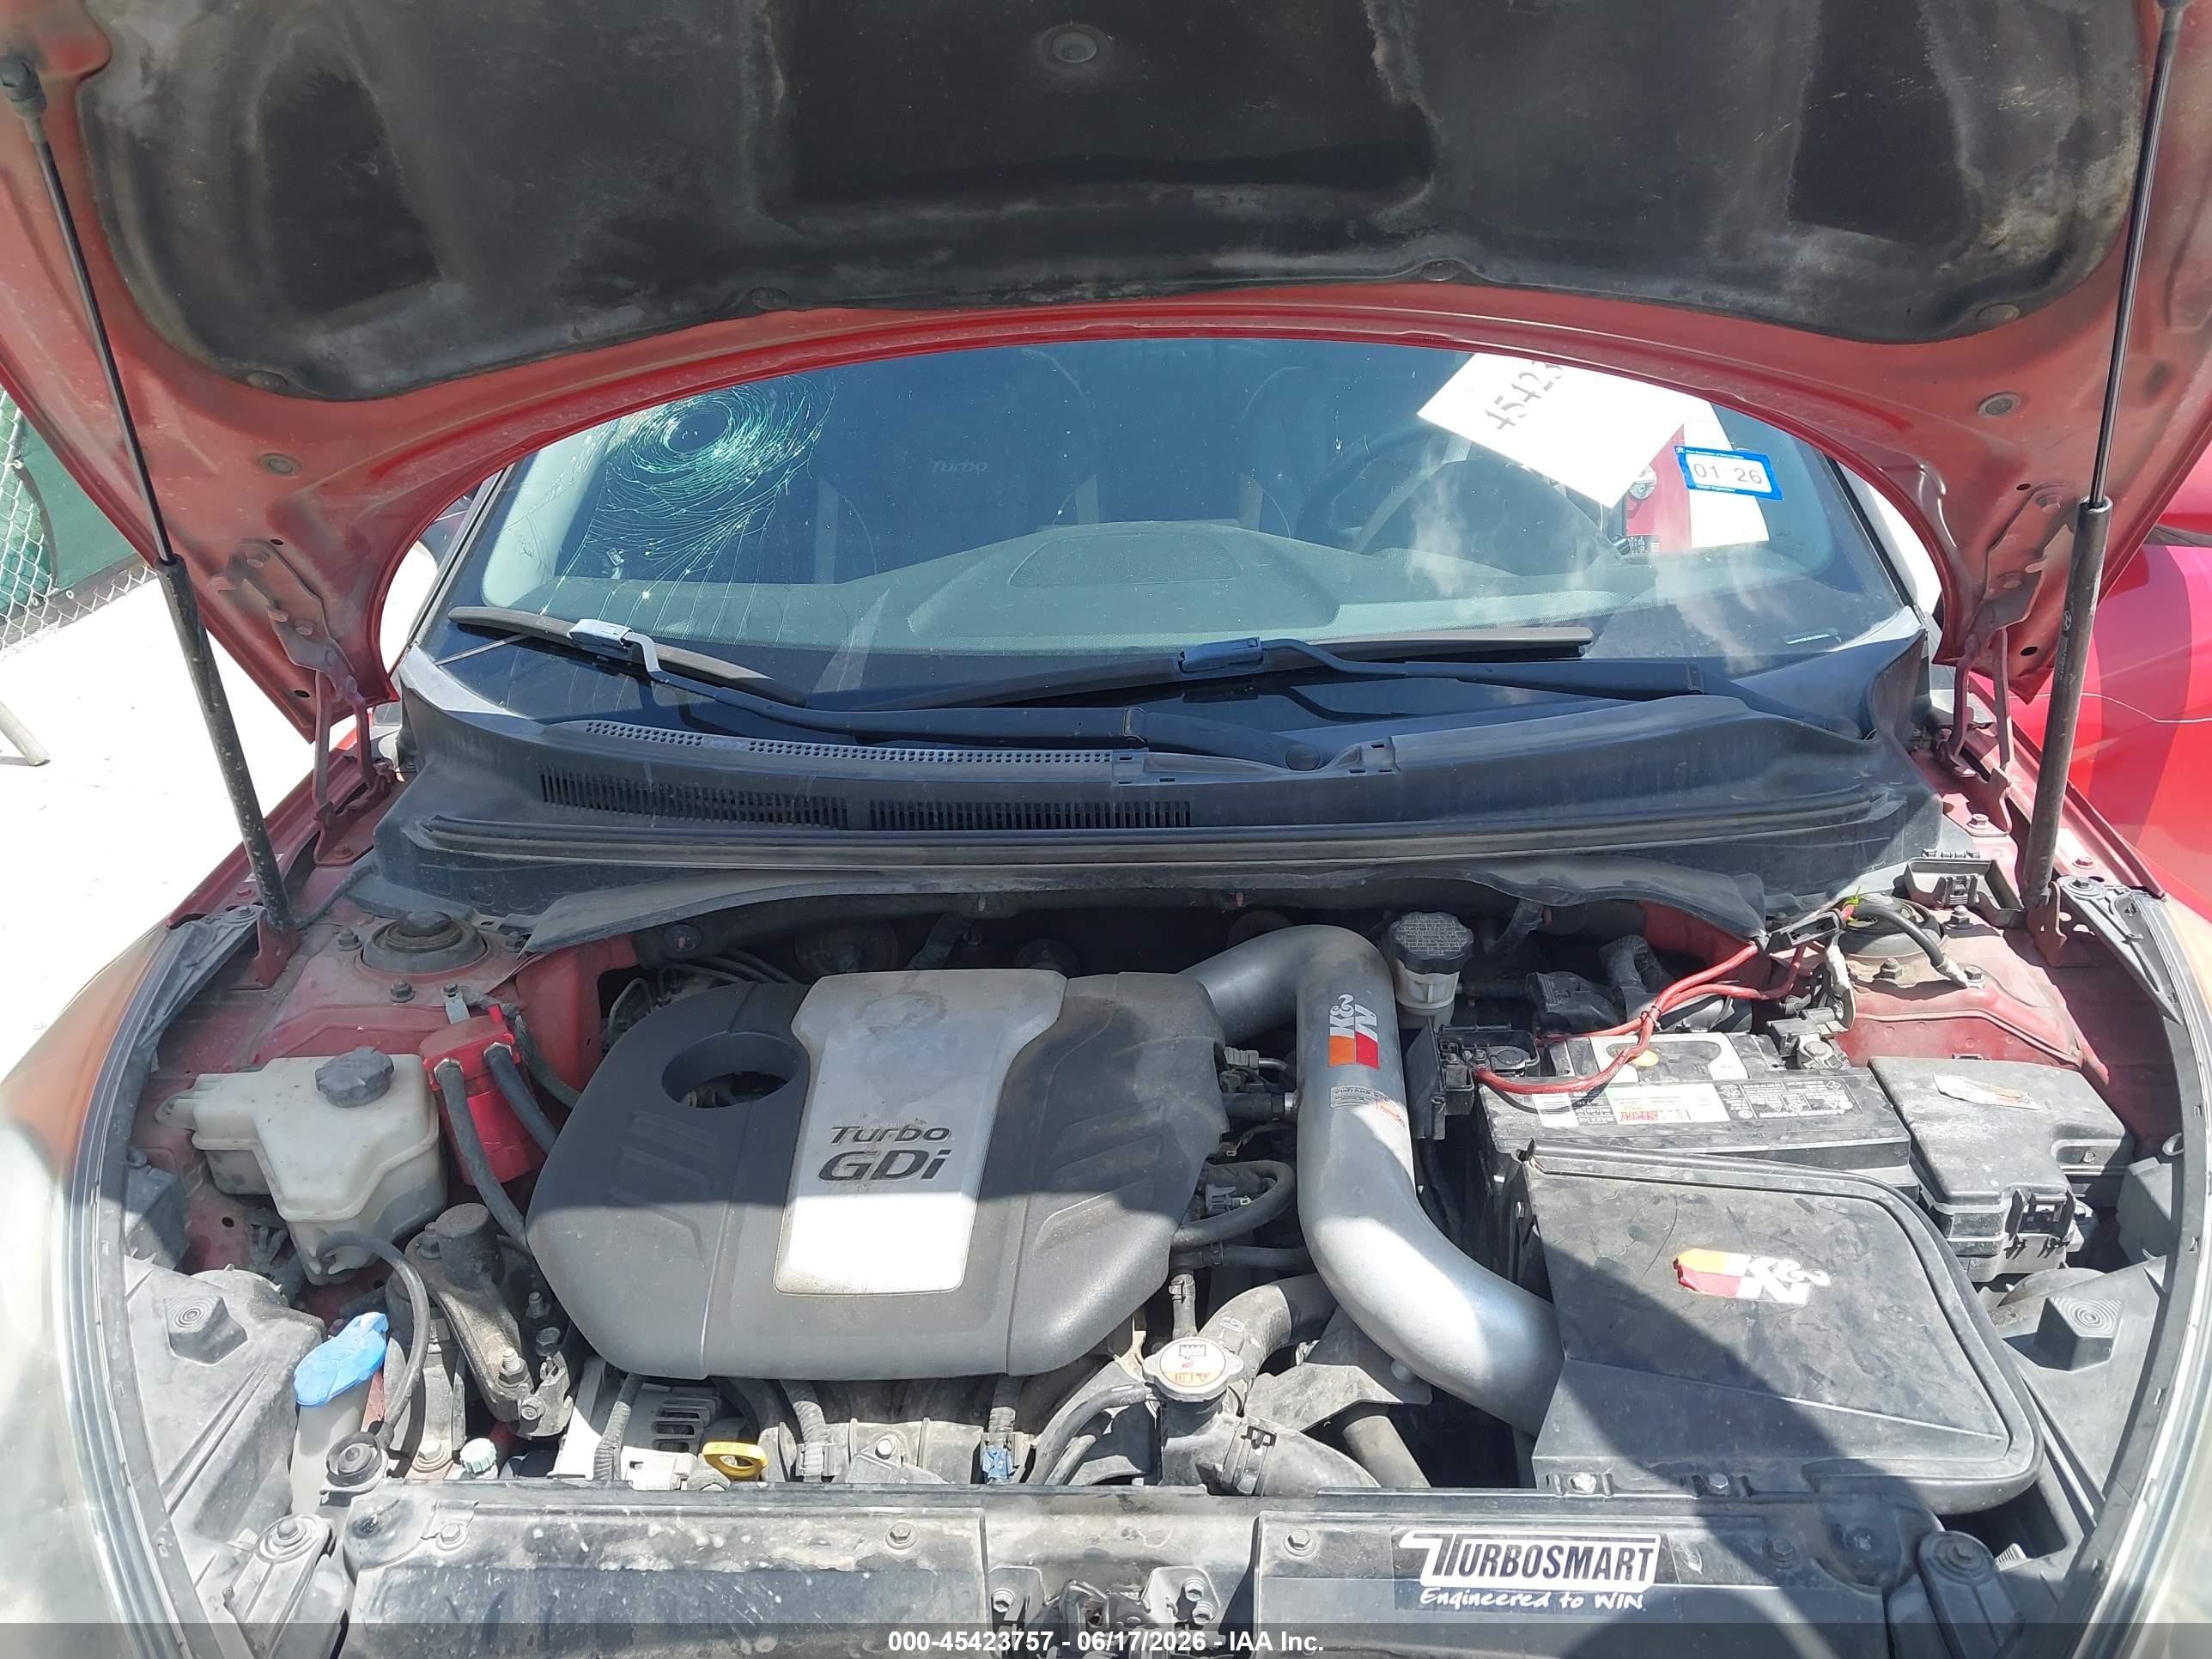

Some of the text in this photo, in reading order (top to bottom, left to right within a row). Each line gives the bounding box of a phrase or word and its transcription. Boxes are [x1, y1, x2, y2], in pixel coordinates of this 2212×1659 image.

[1693, 463, 1763, 484] 01 26
[830, 1125, 952, 1144] Turbo
[817, 1149, 952, 1181] GDi
[1407, 1531, 1658, 1584] TURBOSMART
[1420, 1588, 1550, 1610] Engineered
[1559, 1591, 1585, 1608] to
